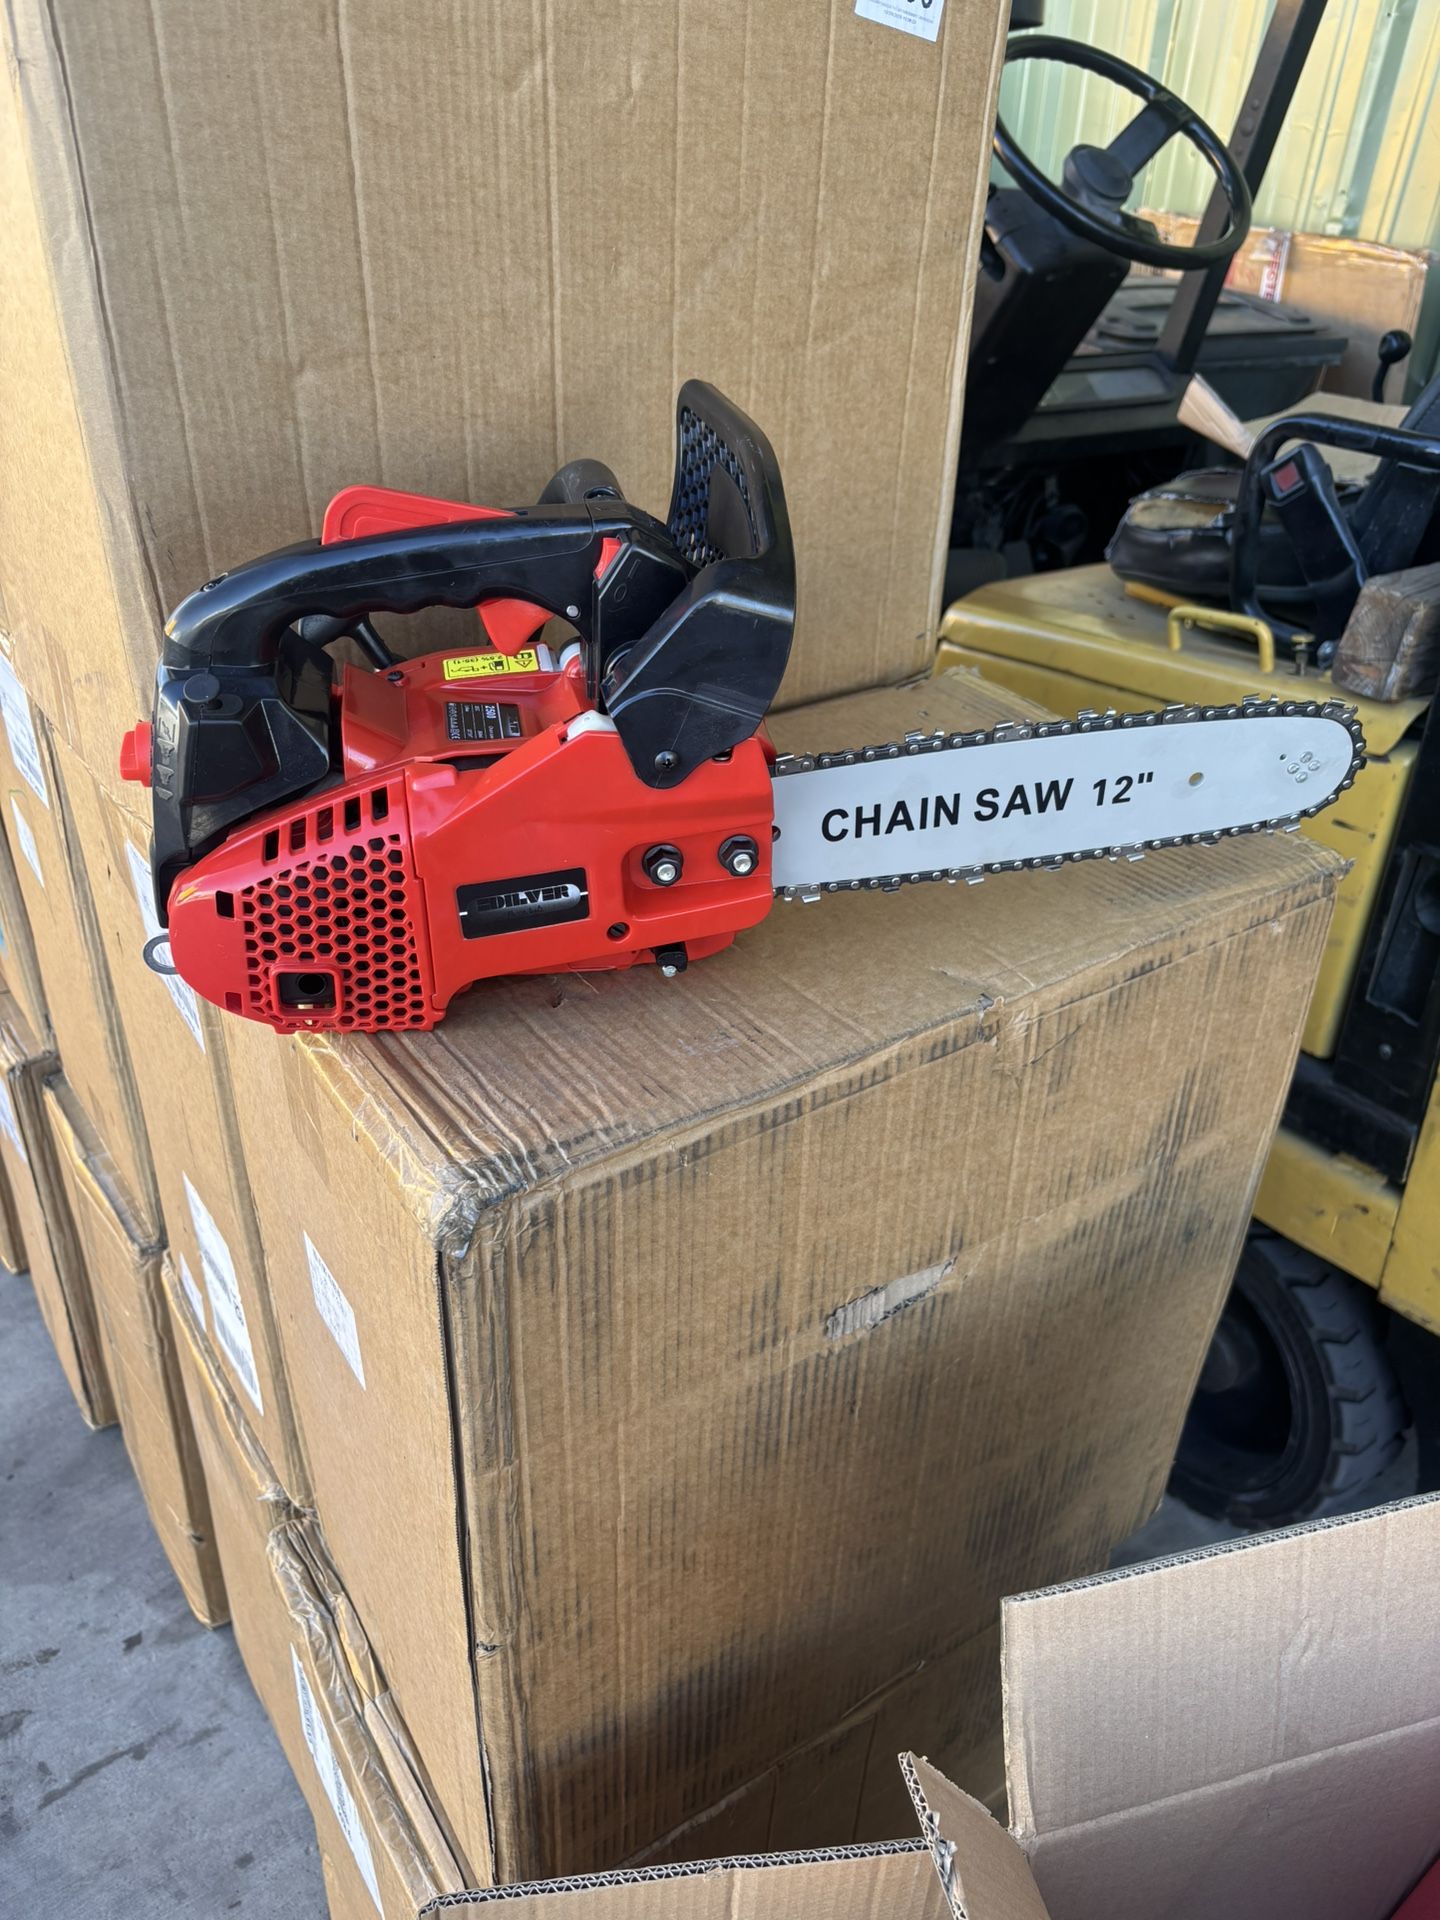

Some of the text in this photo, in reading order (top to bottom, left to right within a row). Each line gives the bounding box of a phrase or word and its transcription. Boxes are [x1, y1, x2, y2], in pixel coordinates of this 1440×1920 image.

[821, 771, 1154, 842] CHAIN SAW 12"
